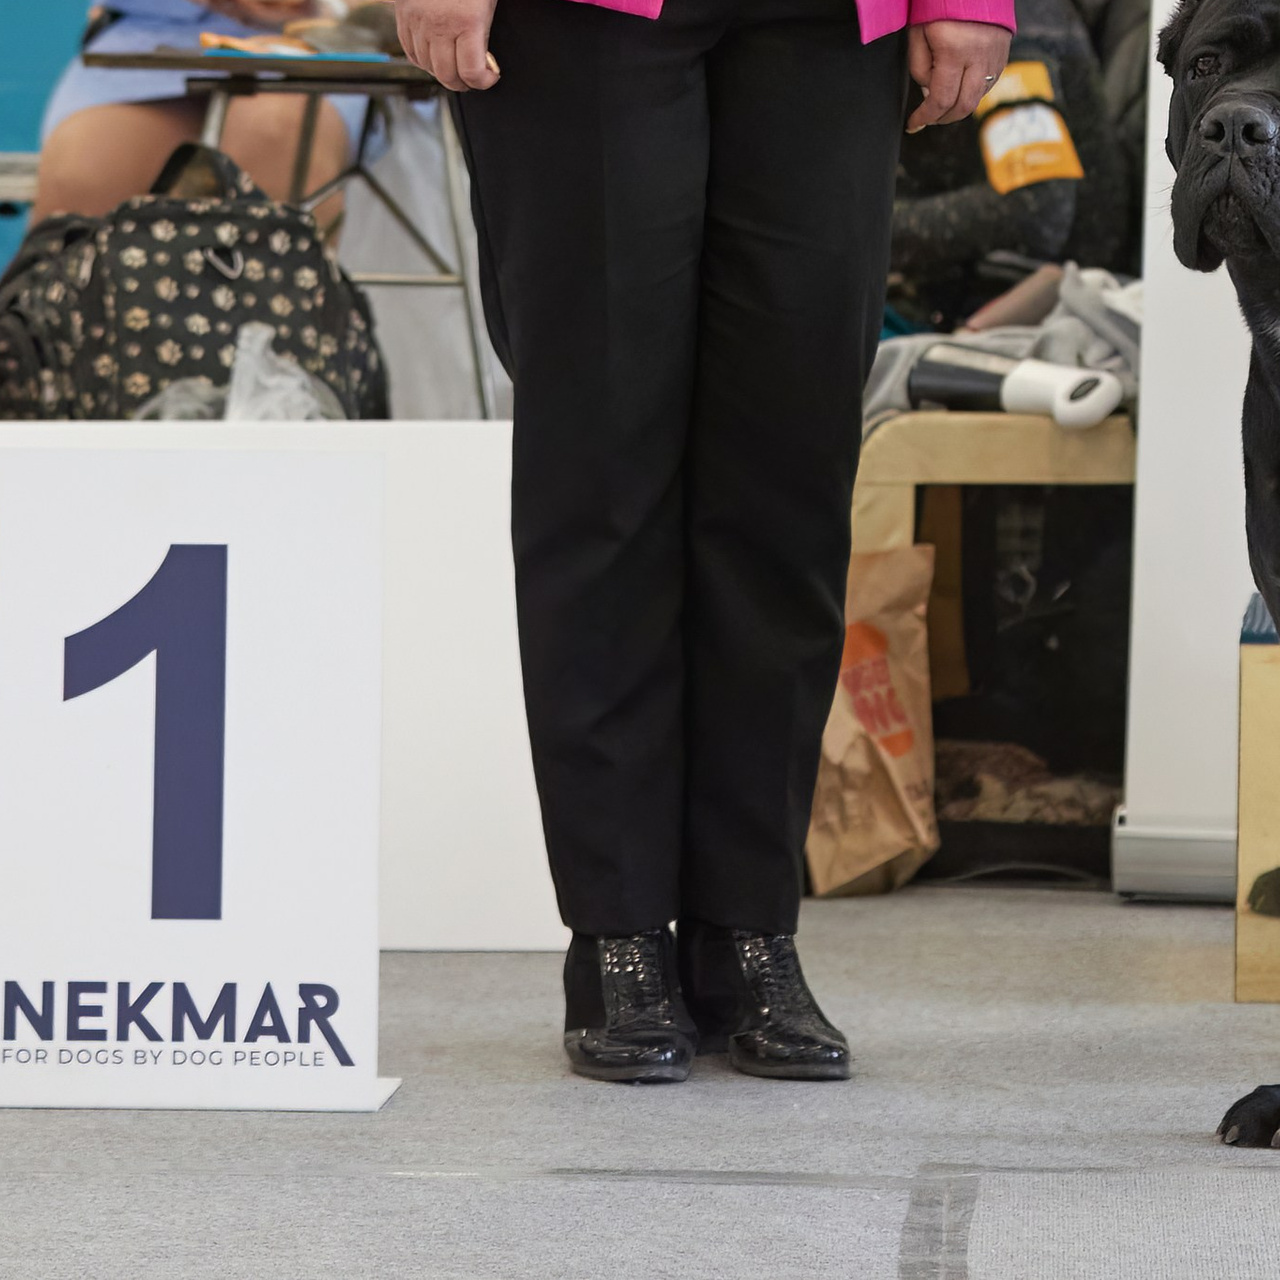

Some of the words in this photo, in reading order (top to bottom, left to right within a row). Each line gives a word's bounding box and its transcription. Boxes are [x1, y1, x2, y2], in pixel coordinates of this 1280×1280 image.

[63, 544, 228, 920] 1
[2, 1048, 49, 1064] FOR
[58, 1048, 125, 1065] DOGS
[133, 1049, 163, 1065] BY
[172, 1050, 223, 1066] DOG
[233, 1050, 326, 1067] PEOPLE
[3, 980, 356, 1067] NEKMAR
